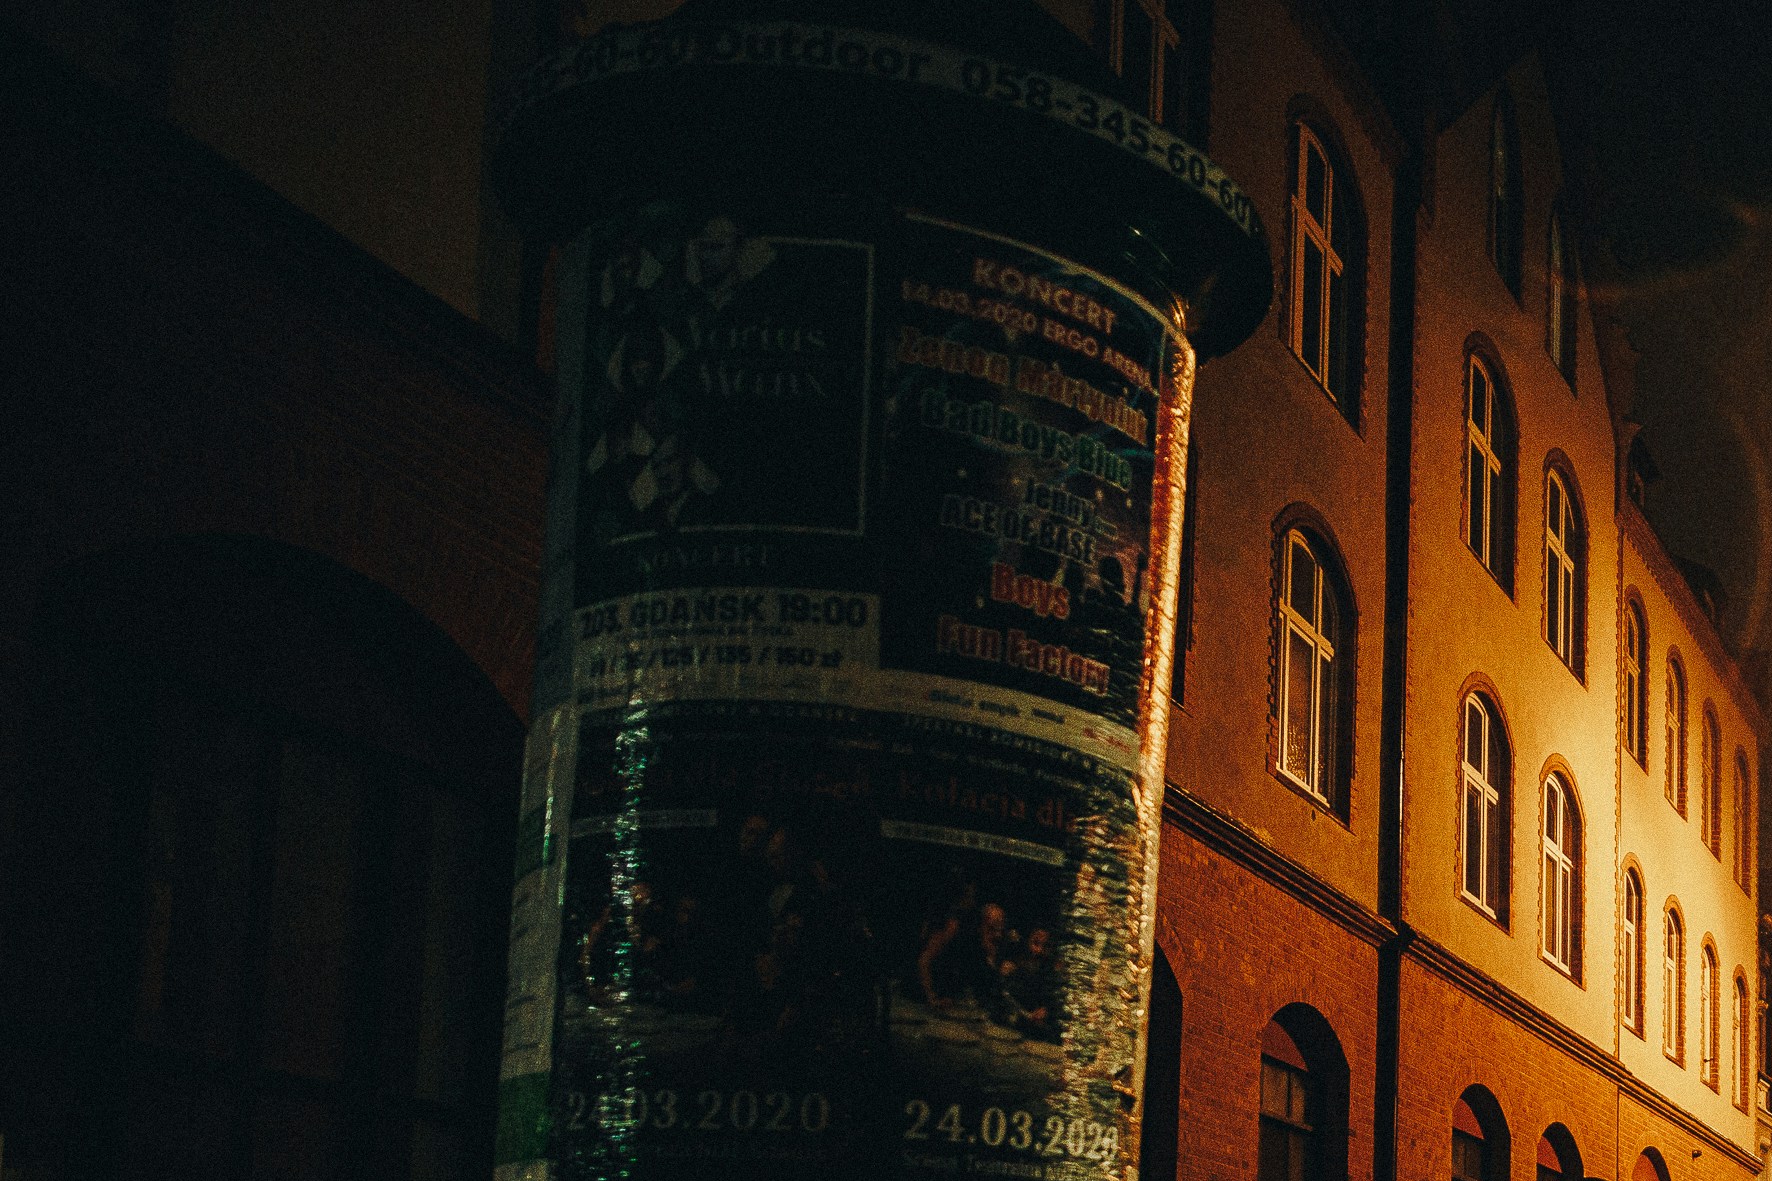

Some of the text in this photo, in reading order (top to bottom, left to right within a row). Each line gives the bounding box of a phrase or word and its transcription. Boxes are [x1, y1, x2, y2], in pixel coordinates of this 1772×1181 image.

[709, 25, 931, 79] Outdoor
[962, 57, 1251, 223] 058-345-60-60
[901, 277, 1038, 333] 14.03.2020
[1042, 315, 1100, 359] ERGO
[971, 256, 1118, 337] KONCERT
[778, 593, 869, 628] 19:00
[990, 561, 1072, 621] Boys
[936, 613, 1111, 698] Fun Factory
